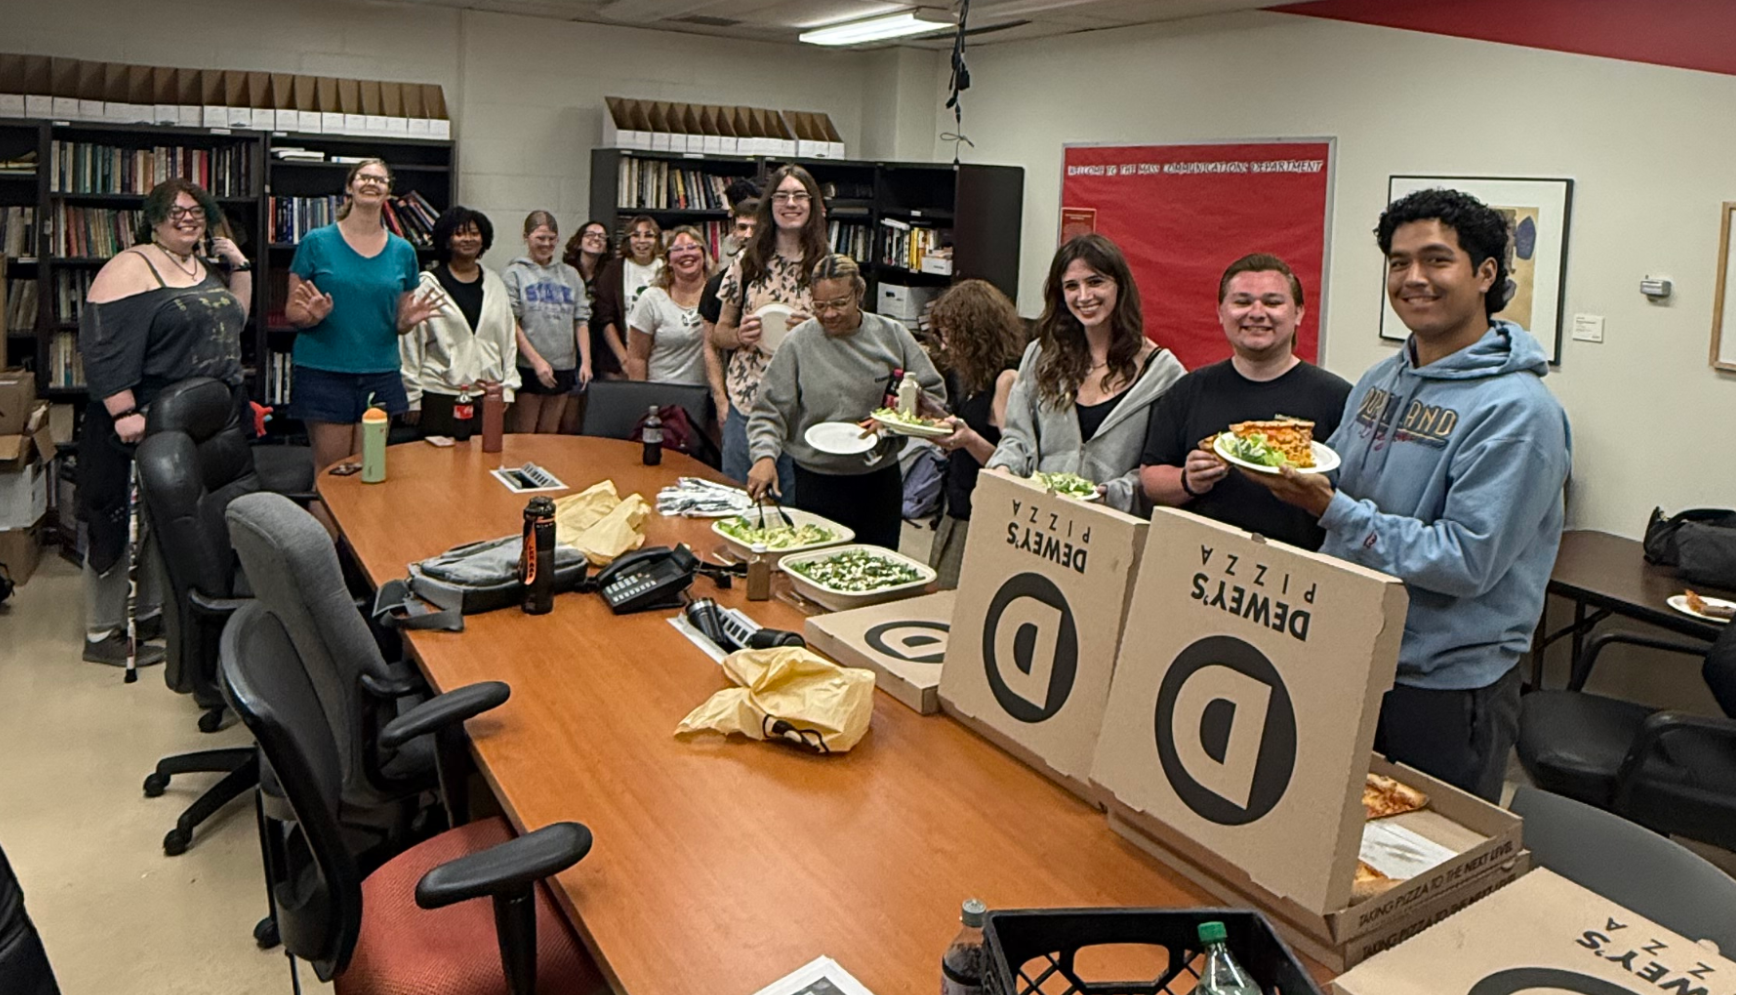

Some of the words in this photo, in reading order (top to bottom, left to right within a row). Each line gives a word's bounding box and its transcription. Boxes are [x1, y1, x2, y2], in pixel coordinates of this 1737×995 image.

[1068, 165, 1105, 176] WELCOME
[1106, 165, 1117, 176] TO
[1120, 164, 1136, 175] THE
[1138, 163, 1160, 174] MASS
[1250, 160, 1323, 173] DEPARTMENT
[1006, 521, 1088, 574] DEWEY'S
[1012, 498, 1091, 544] PIZZA
[1200, 544, 1318, 604] PIZZA
[1190, 572, 1311, 642] DEWEY'S
[1359, 900, 1395, 928] TAKING
[1395, 883, 1429, 908] PIZZA
[1430, 875, 1444, 891] TO
[1446, 865, 1463, 882] THE
[1464, 852, 1490, 874] NEXT
[1490, 840, 1514, 861] LEVEL
[1575, 930, 1710, 995] WEY'S
[1605, 917, 1716, 981] ZZA
